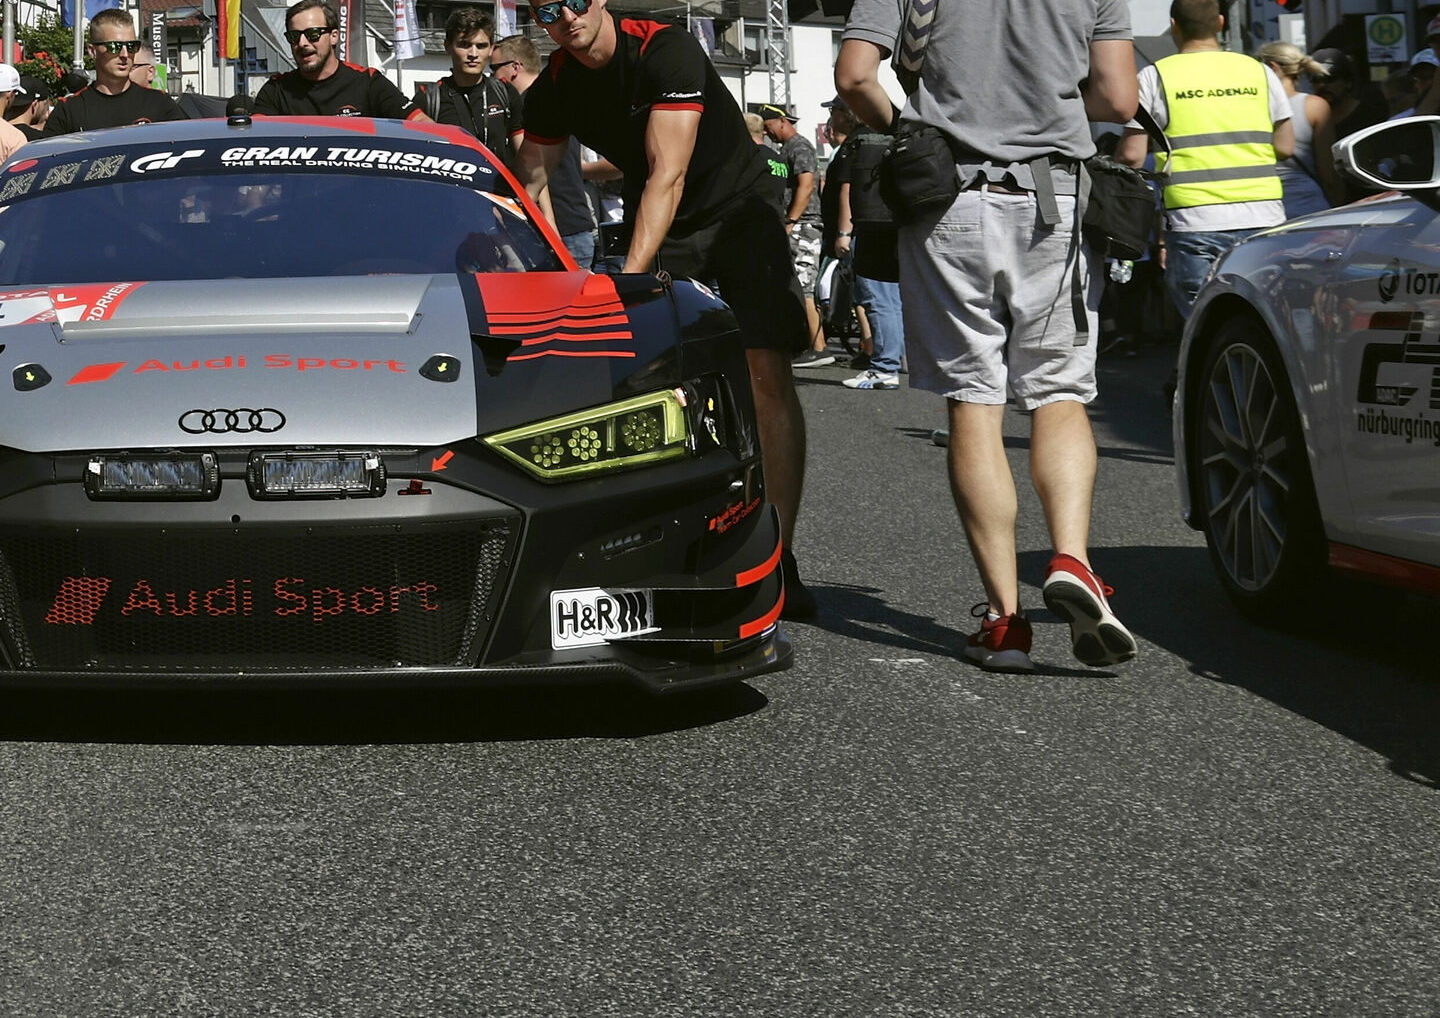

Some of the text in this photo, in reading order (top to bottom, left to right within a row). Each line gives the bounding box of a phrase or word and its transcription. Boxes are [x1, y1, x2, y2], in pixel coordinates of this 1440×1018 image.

[339, 5, 349, 62] RACING
[1175, 87, 1258, 100] MSC ADENAU
[221, 147, 478, 175] GRAN TURISMO
[258, 159, 302, 167] REAL
[308, 159, 373, 169] DRIVING
[378, 163, 474, 182] SIMULATOR
[133, 354, 407, 374] Audi Sport
[121, 577, 439, 625] Audi Sport
[558, 597, 614, 635] H&R
